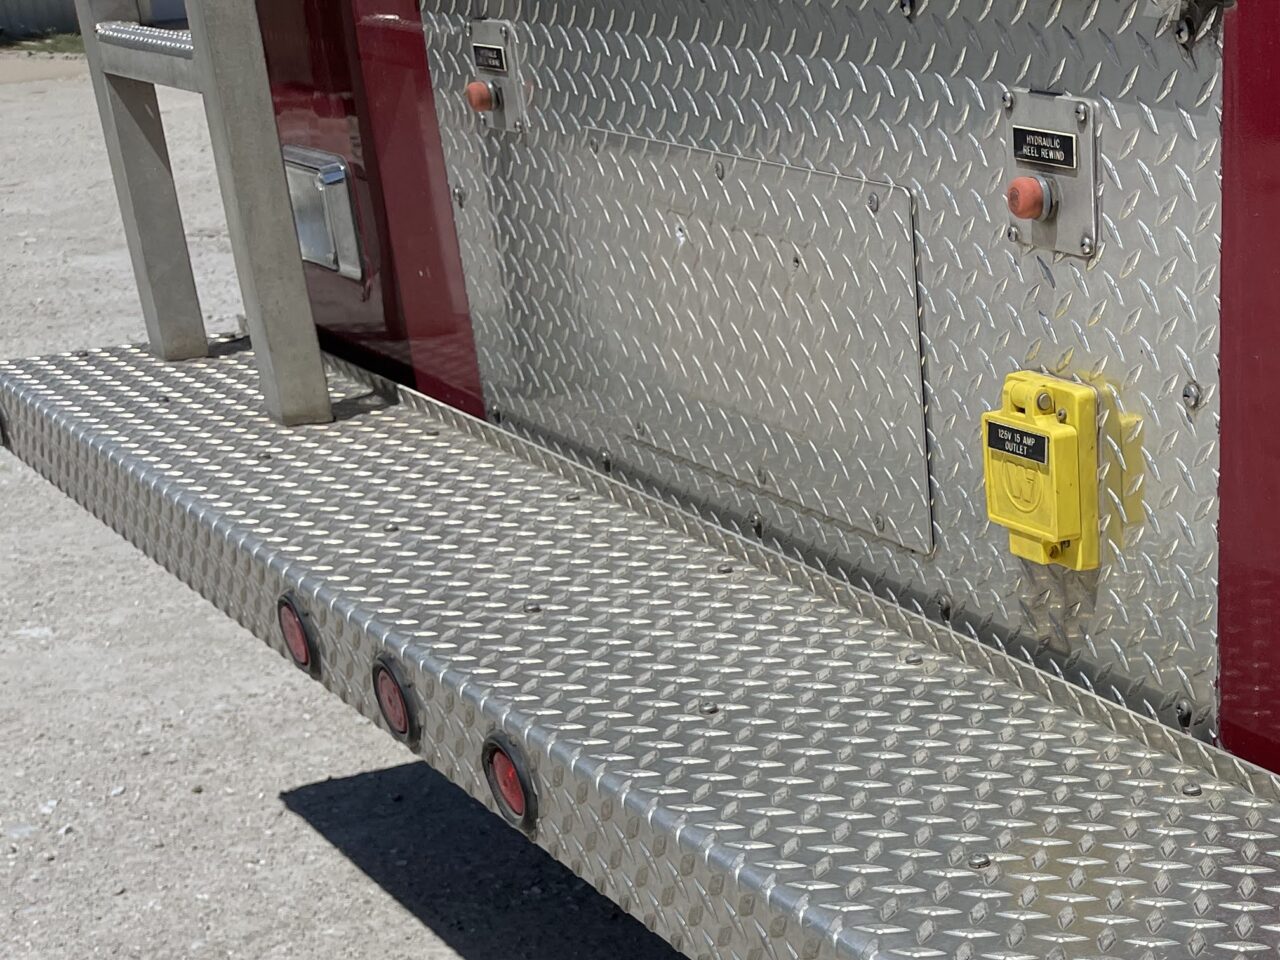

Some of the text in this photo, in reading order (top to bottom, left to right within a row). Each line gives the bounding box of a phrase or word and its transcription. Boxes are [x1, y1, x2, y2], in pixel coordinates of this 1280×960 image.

[1026, 134, 1060, 149] HYDRAULIC
[1023, 144, 1065, 161] REEL REWIND
[998, 428, 1036, 447] 125V 15 AMP
[1004, 441, 1028, 455] OUTLET
